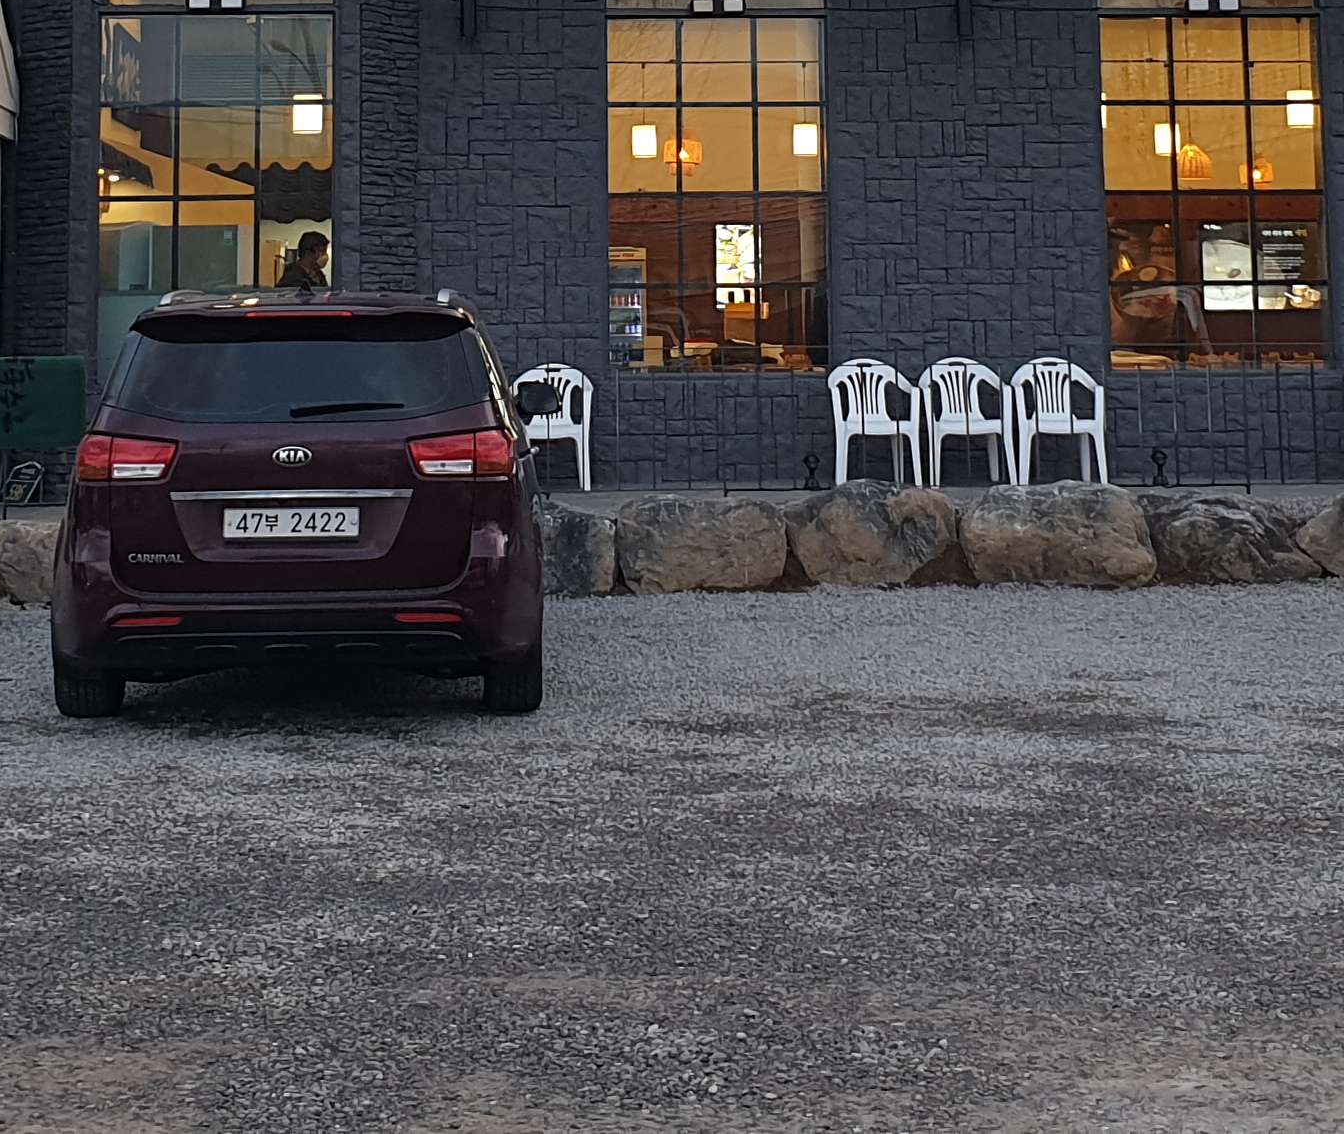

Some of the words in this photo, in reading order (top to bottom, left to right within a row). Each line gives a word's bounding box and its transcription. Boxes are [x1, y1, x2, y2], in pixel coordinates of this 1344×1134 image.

[278, 450, 306, 462] KIA
[235, 512, 279, 534] 47부
[290, 511, 347, 534] 2422
[127, 553, 185, 564] CARNIVAL
